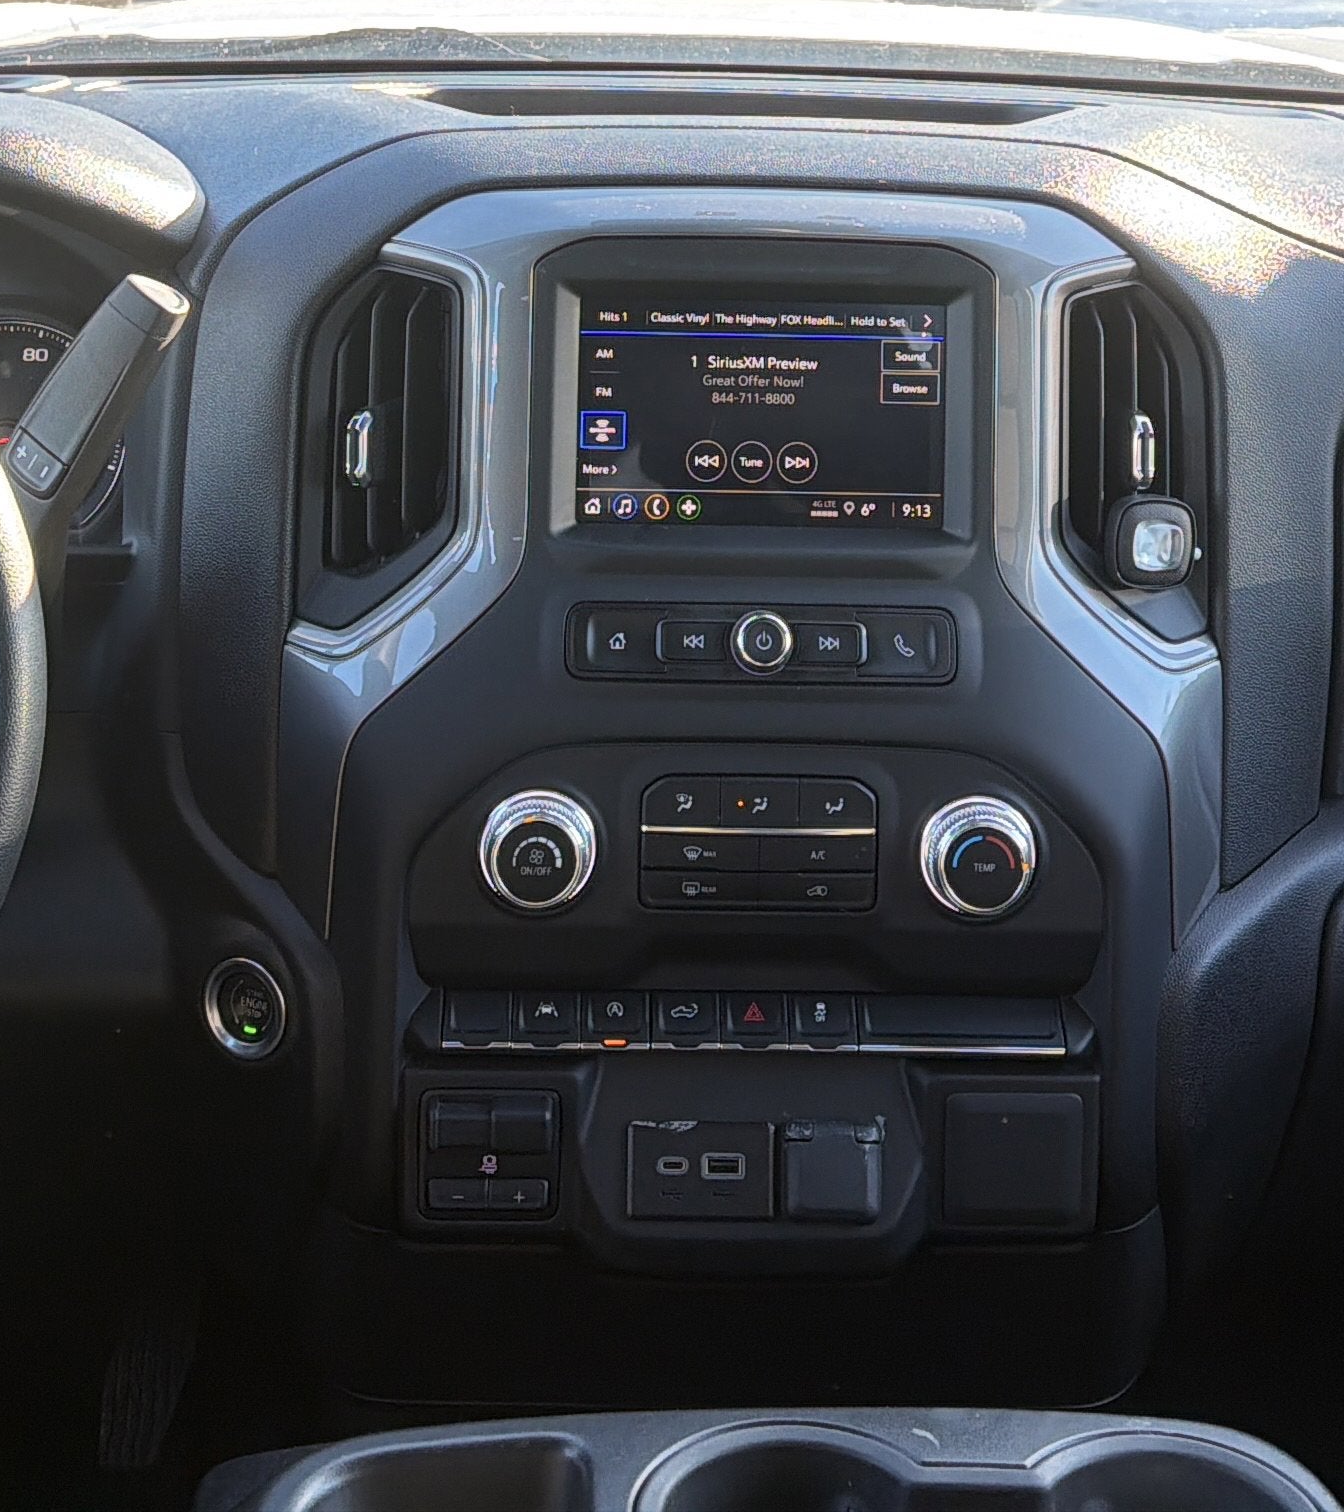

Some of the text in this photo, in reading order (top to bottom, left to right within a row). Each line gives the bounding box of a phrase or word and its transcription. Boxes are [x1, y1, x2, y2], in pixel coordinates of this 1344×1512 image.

[599, 311, 628, 322] Hits 1
[650, 312, 710, 326] Classic Vinyl
[715, 314, 777, 327] The Highway
[781, 315, 844, 327] FOX Headli...
[851, 316, 906, 328] Hold to Set
[22, 348, 49, 362] 80
[595, 349, 614, 359] AM
[895, 352, 926, 363] Sound
[691, 355, 818, 371] 1 SiriusXM Preview
[702, 375, 804, 388] Great Offer Now!
[595, 387, 613, 397] FM
[892, 383, 929, 394] Browse
[711, 393, 795, 405] 844-711-8800
[739, 457, 764, 468] Tune
[582, 464, 609, 475] More
[812, 500, 823, 508] 4G
[902, 504, 931, 518] 9:13
[810, 849, 826, 860] A/C
[520, 865, 552, 877] ON/OFF
[973, 862, 996, 873] TEMP
